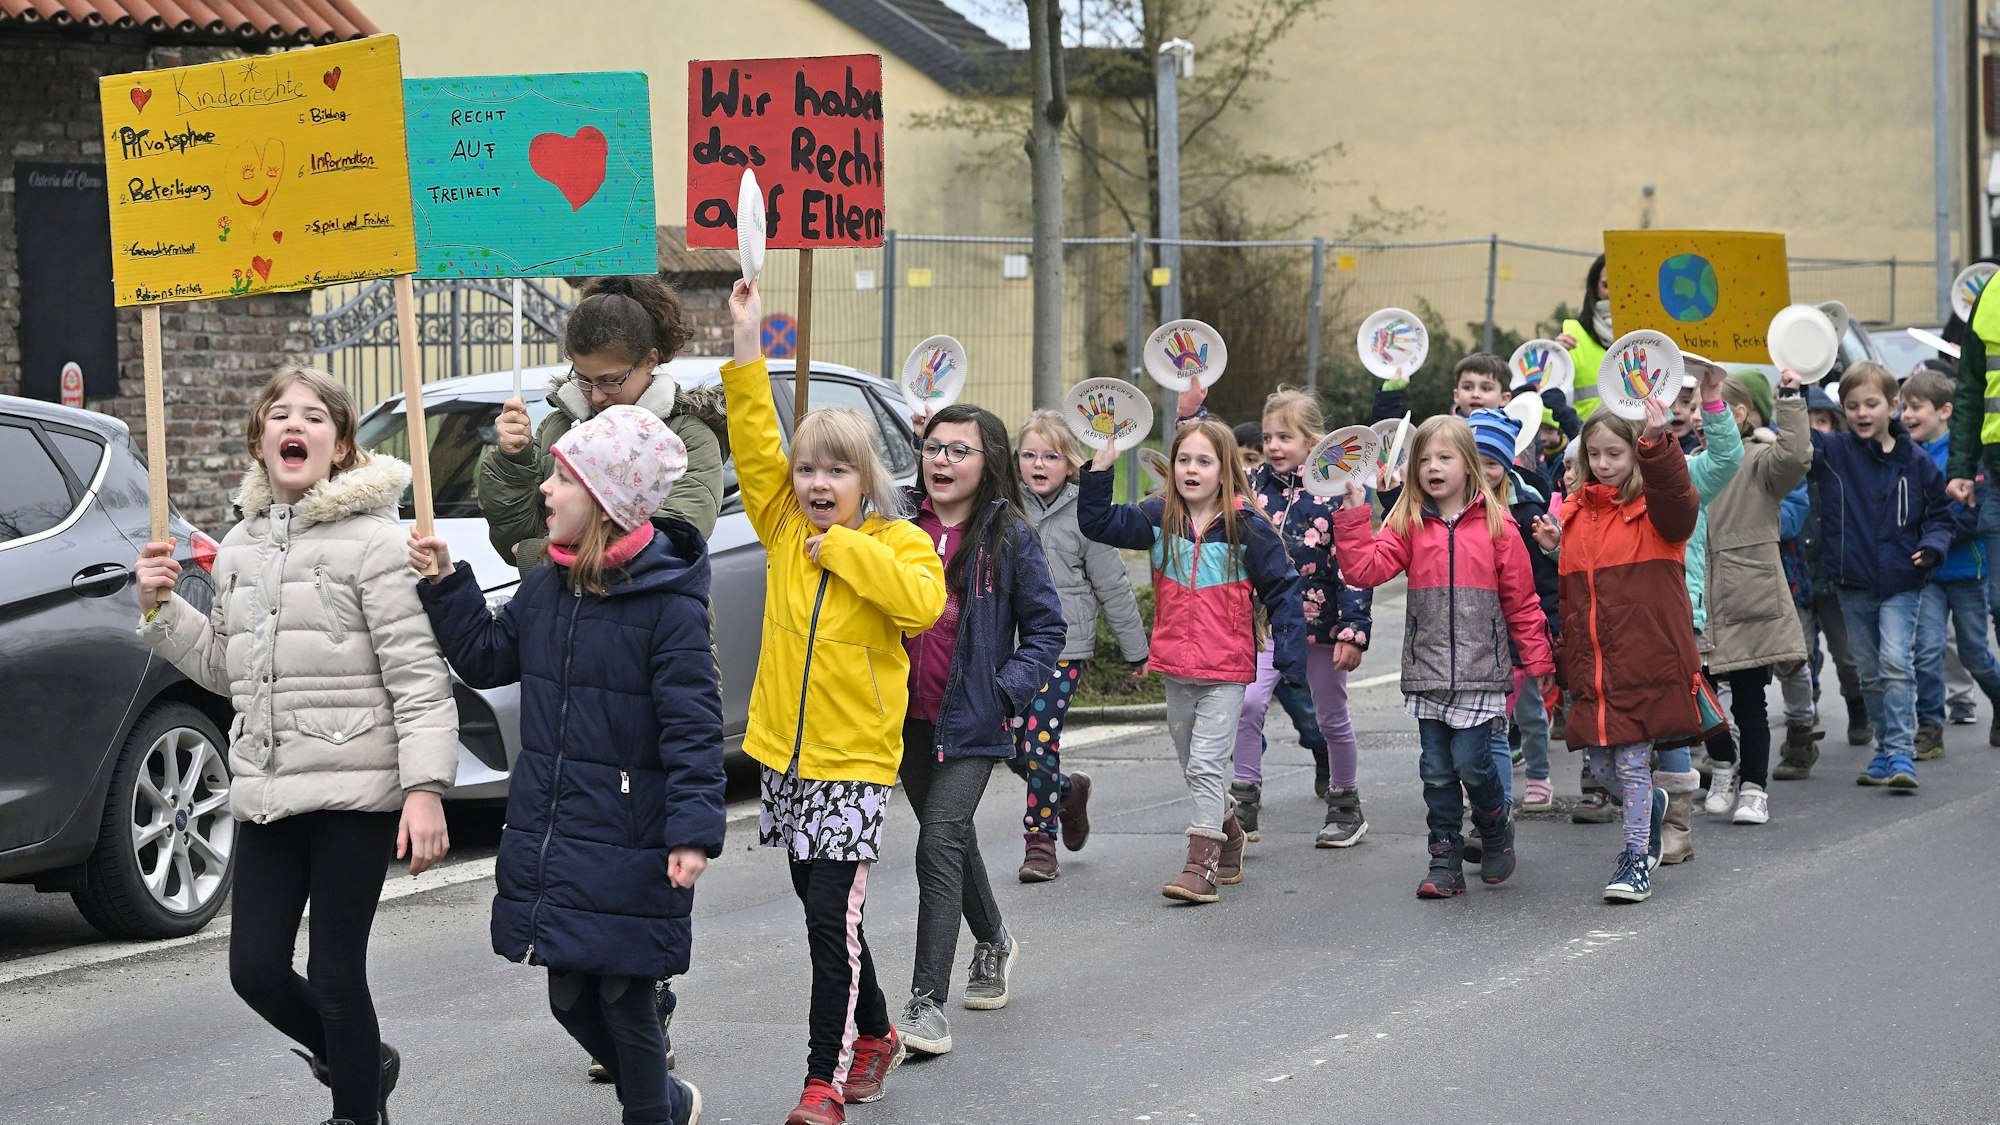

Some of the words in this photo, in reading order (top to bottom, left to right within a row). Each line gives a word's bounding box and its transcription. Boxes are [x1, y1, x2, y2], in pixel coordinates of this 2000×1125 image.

[172, 68, 307, 112] Kinderrechte
[702, 67, 772, 117] Wir
[795, 66, 884, 121] haben
[309, 107, 347, 122] Bildung
[451, 109, 507, 126] RECHT
[311, 149, 375, 171] Information
[450, 139, 496, 161] AUF
[693, 126, 766, 167] das
[791, 126, 882, 187] Recht
[128, 177, 213, 201] Beteiligung
[427, 186, 501, 203] FREIHEIT
[313, 217, 339, 235] Spiel
[343, 214, 357, 229] und
[364, 212, 390, 226] Freiheit
[694, 184, 784, 239] af
[801, 189, 884, 241] Eltern
[1155, 326, 1178, 344] RECHT
[1684, 332, 1719, 349] haben
[1177, 365, 1209, 379] BILDUNG
[1079, 384, 1134, 400] KINDERRECHTE
[1362, 441, 1377, 467] RECHT
